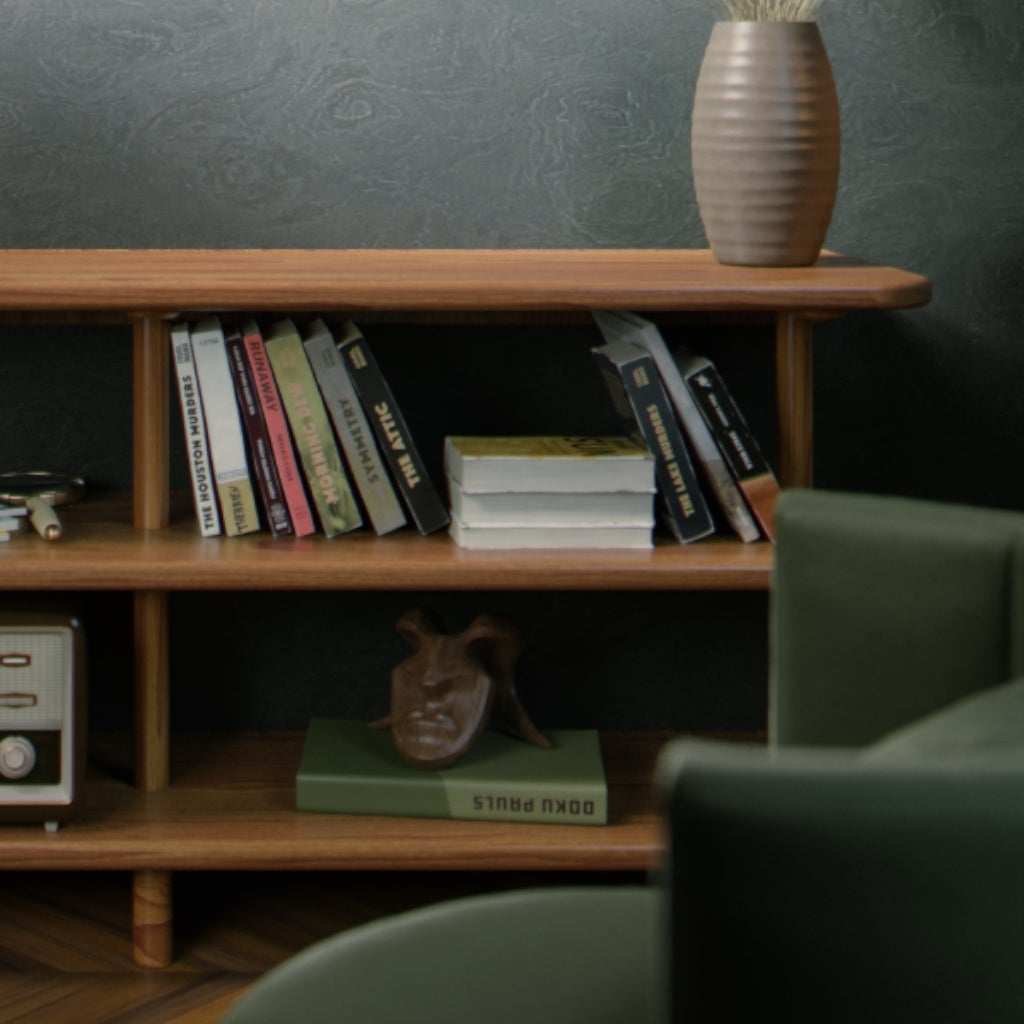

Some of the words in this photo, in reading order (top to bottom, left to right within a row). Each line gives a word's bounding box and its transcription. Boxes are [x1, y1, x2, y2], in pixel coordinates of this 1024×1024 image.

[250, 342, 278, 412] RUNAWAY
[182, 375, 199, 437] MURDERS
[374, 401, 406, 450] ATTIC
[646, 404, 676, 461] MURDERS
[303, 422, 340, 504] MORNING
[338, 399, 379, 484] SYMMETRY
[191, 440, 210, 502] HOUSTON
[397, 455, 421, 489] THE
[202, 505, 215, 530] THE
[678, 493, 696, 519] THE
[473, 796, 534, 812] PAULS
[542, 799, 594, 815] DOKU
